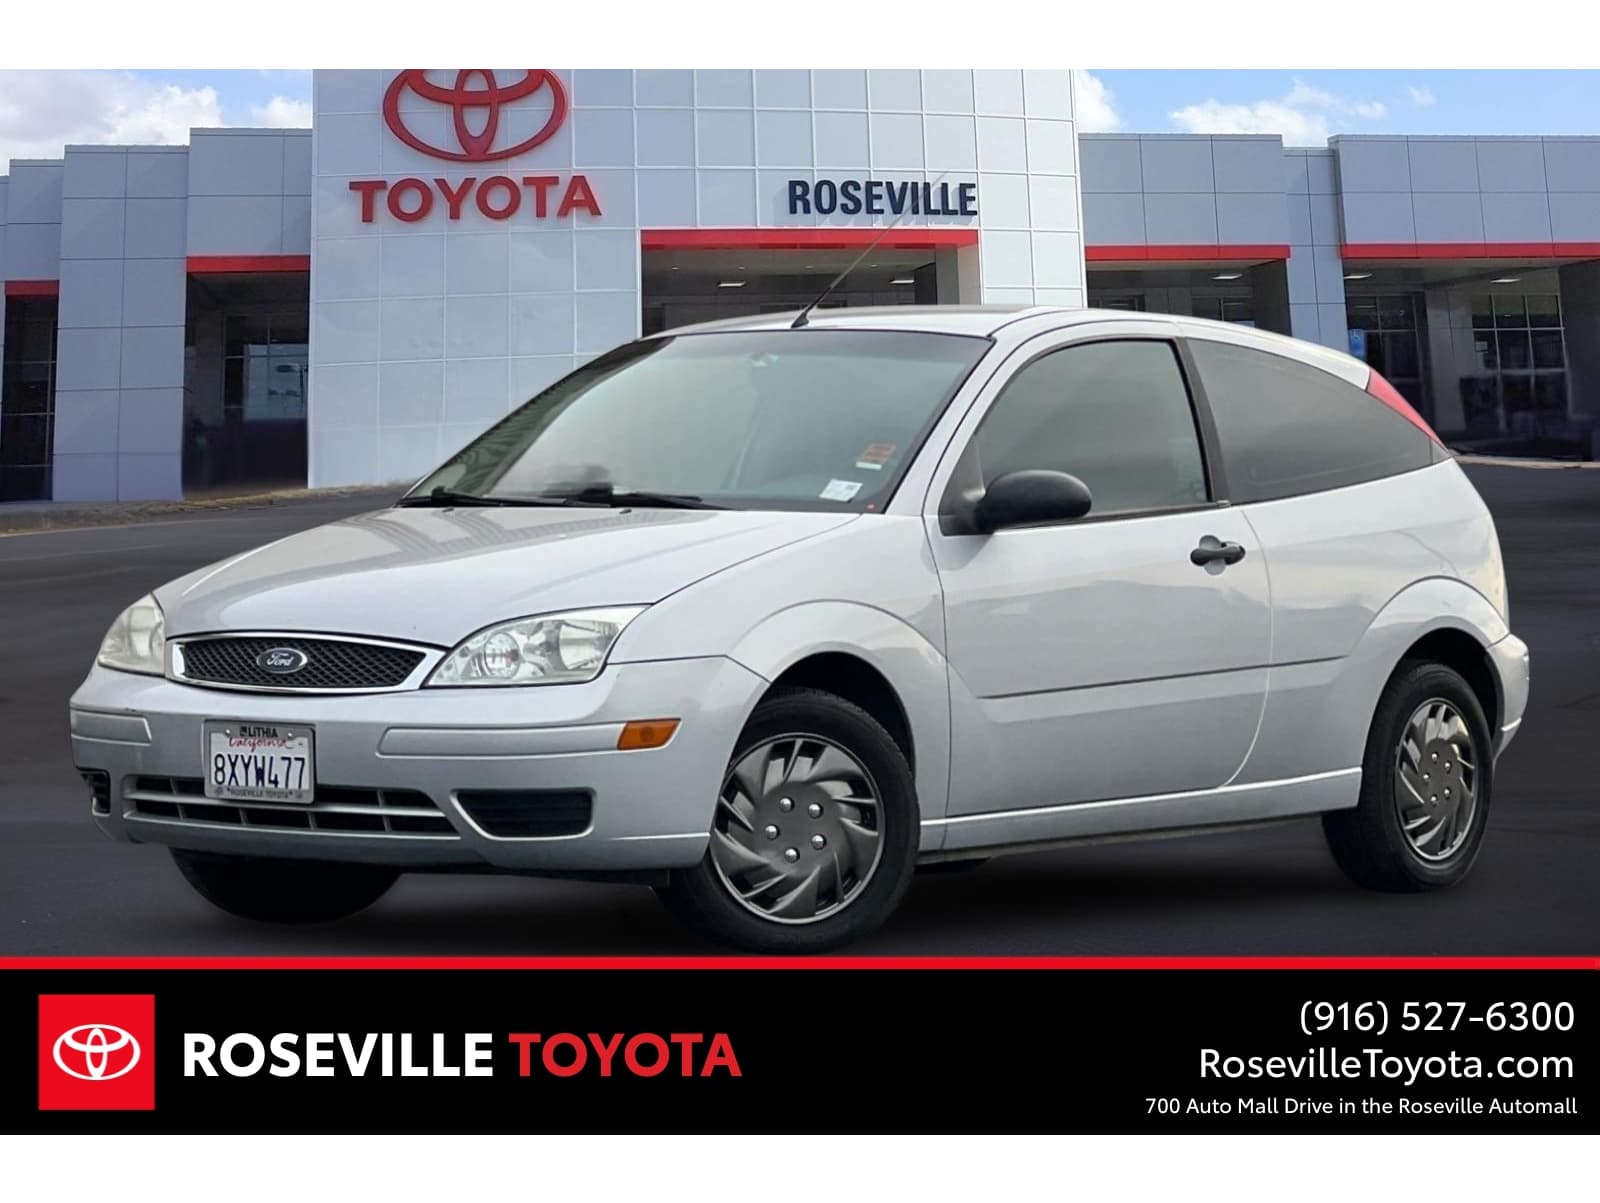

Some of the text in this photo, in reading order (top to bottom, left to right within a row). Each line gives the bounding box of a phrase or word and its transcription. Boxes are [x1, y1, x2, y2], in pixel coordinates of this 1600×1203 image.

[349, 175, 602, 223] TOYOTA
[788, 179, 978, 217] ROSEVILLE
[267, 652, 294, 666] Ford
[248, 727, 278, 738] LITHIA
[214, 753, 305, 789] 8XYW477
